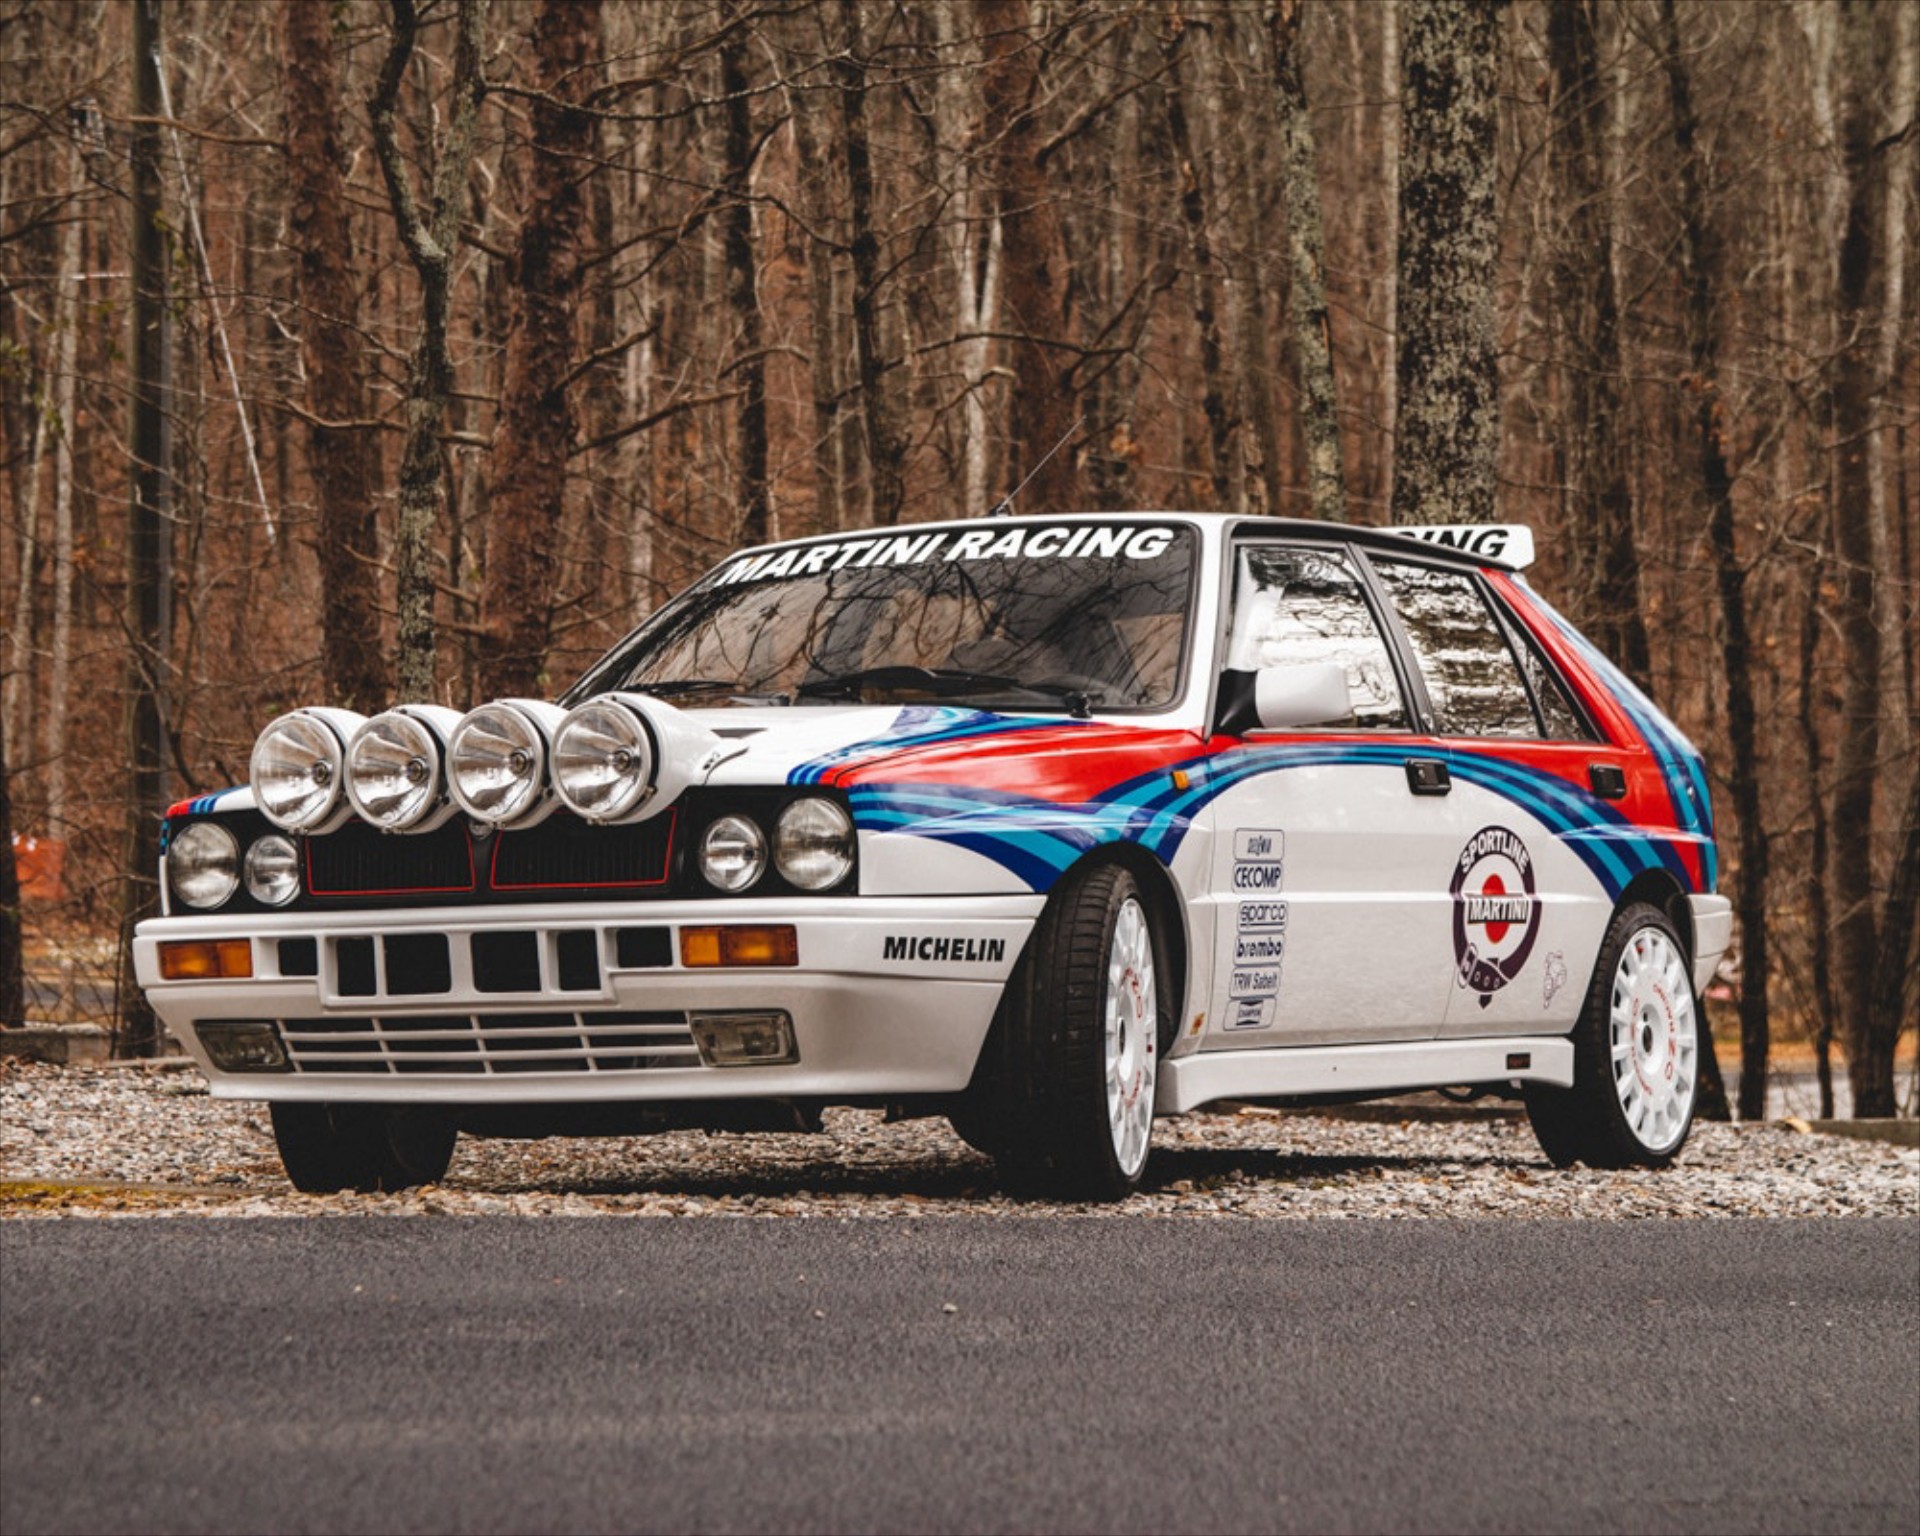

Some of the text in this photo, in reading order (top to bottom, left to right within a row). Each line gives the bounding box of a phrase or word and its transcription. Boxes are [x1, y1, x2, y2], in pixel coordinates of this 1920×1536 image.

[713, 527, 1174, 587] MARTINI RACING
[1460, 831, 1530, 873] SPORTLINE
[1235, 866, 1281, 888] CECOMP
[1240, 904, 1286, 926] sparco
[1470, 899, 1527, 920] MARTINI
[883, 936, 1005, 962] MICHELIN
[1237, 936, 1282, 958] brembo
